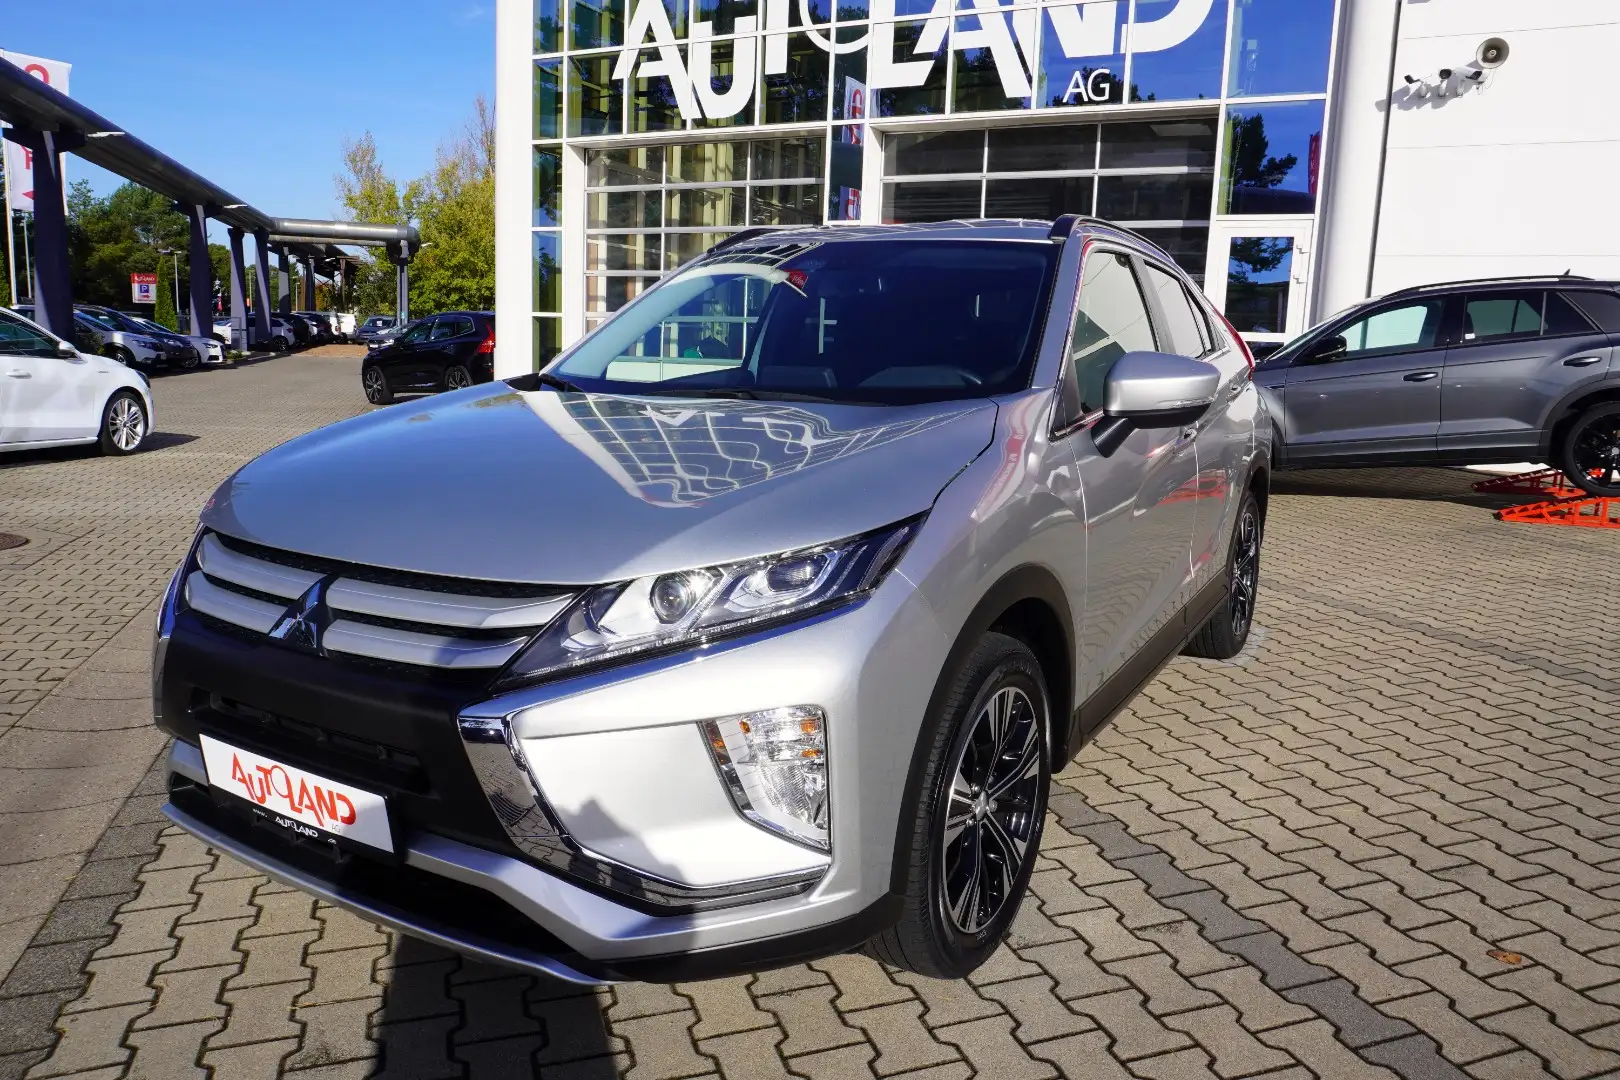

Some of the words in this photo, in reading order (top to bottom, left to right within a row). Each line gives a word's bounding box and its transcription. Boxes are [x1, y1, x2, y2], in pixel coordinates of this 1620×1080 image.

[1063, 69, 1110, 103] AG
[232, 752, 356, 827] AUTOLAND
[275, 816, 319, 838] AUTOLAND
